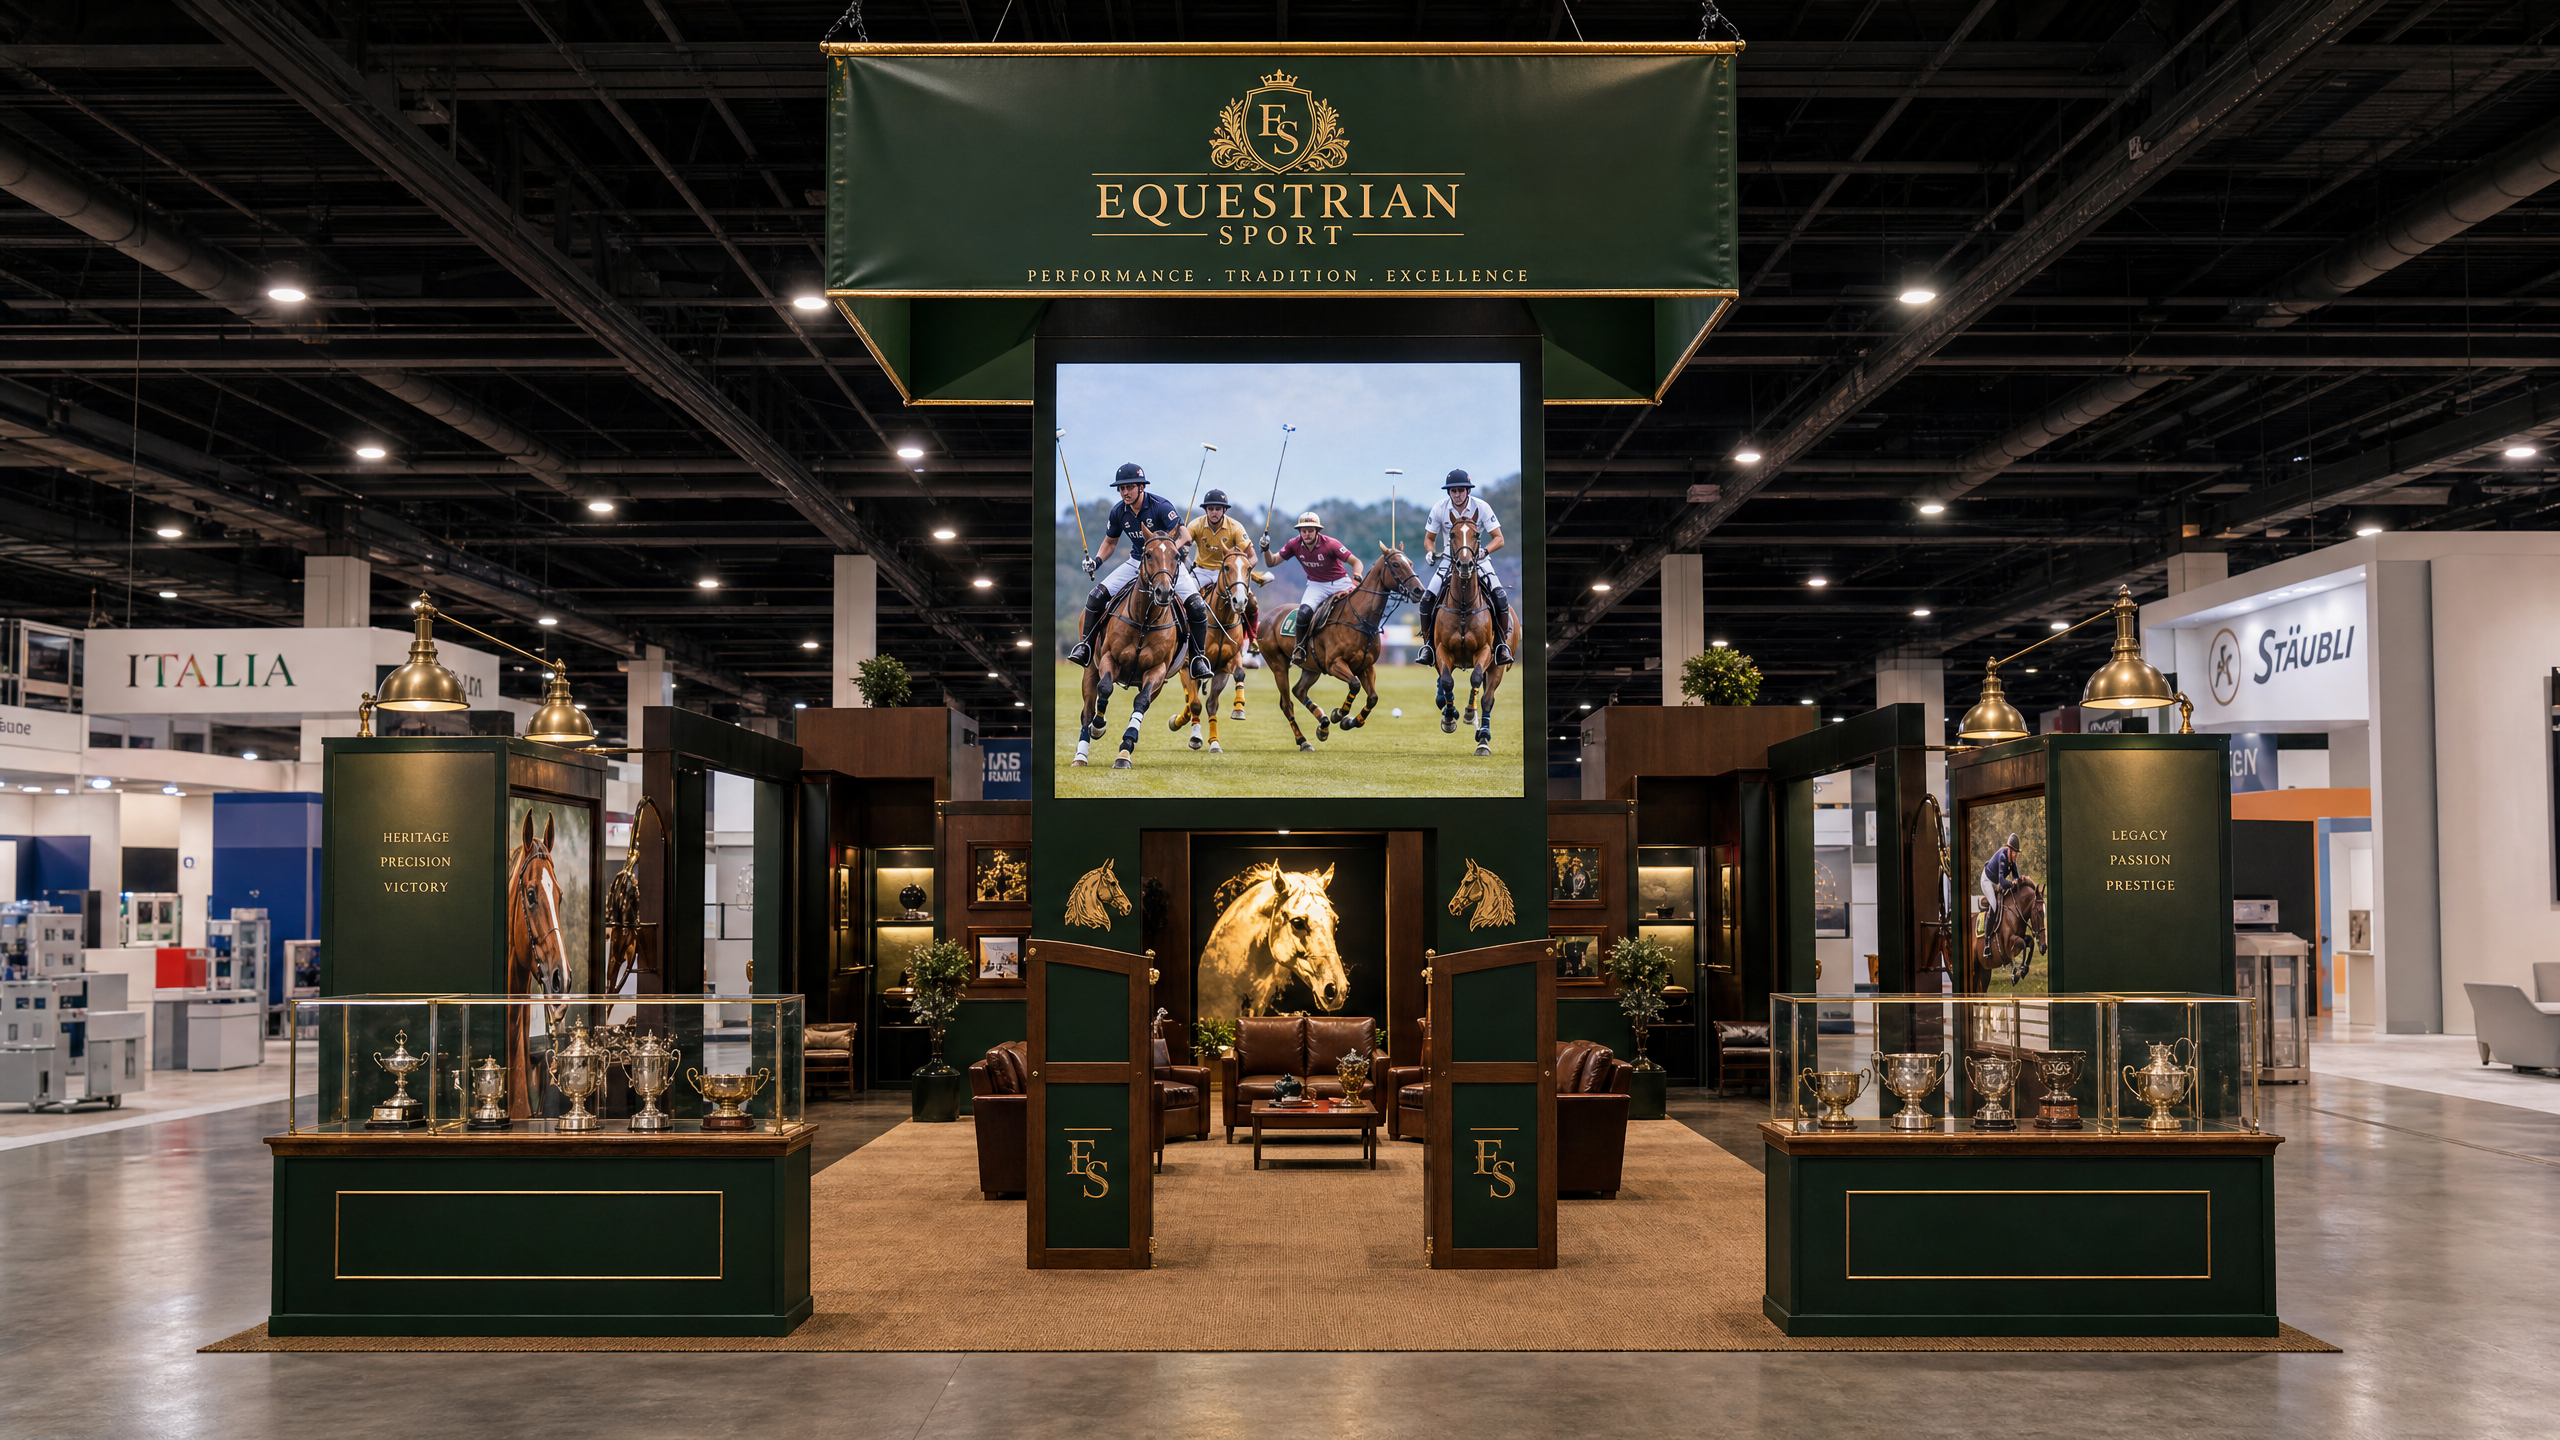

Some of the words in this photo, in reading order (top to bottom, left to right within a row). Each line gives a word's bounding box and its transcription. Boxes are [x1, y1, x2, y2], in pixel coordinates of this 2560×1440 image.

[1258, 103, 1299, 155] ES
[1096, 183, 1460, 228] EQUESTRIAN
[1219, 225, 1343, 246] SPORT
[1028, 269, 1194, 283] PERFORMANCE
[1225, 269, 1357, 283] TRADITION
[1386, 269, 1528, 283] EXCELLENCE
[126, 653, 298, 688] ITALIA
[2230, 747, 2258, 777] EN
[383, 832, 450, 843] HERITAGE
[2112, 829, 2168, 841] LEGACY
[380, 856, 451, 868] PRECISION
[2110, 854, 2171, 866] PASSION
[383, 881, 448, 893] VICTORY
[2106, 880, 2175, 891] PRESTIGE
[1066, 1139, 1109, 1198] ES
[1473, 1139, 1516, 1198] ES
